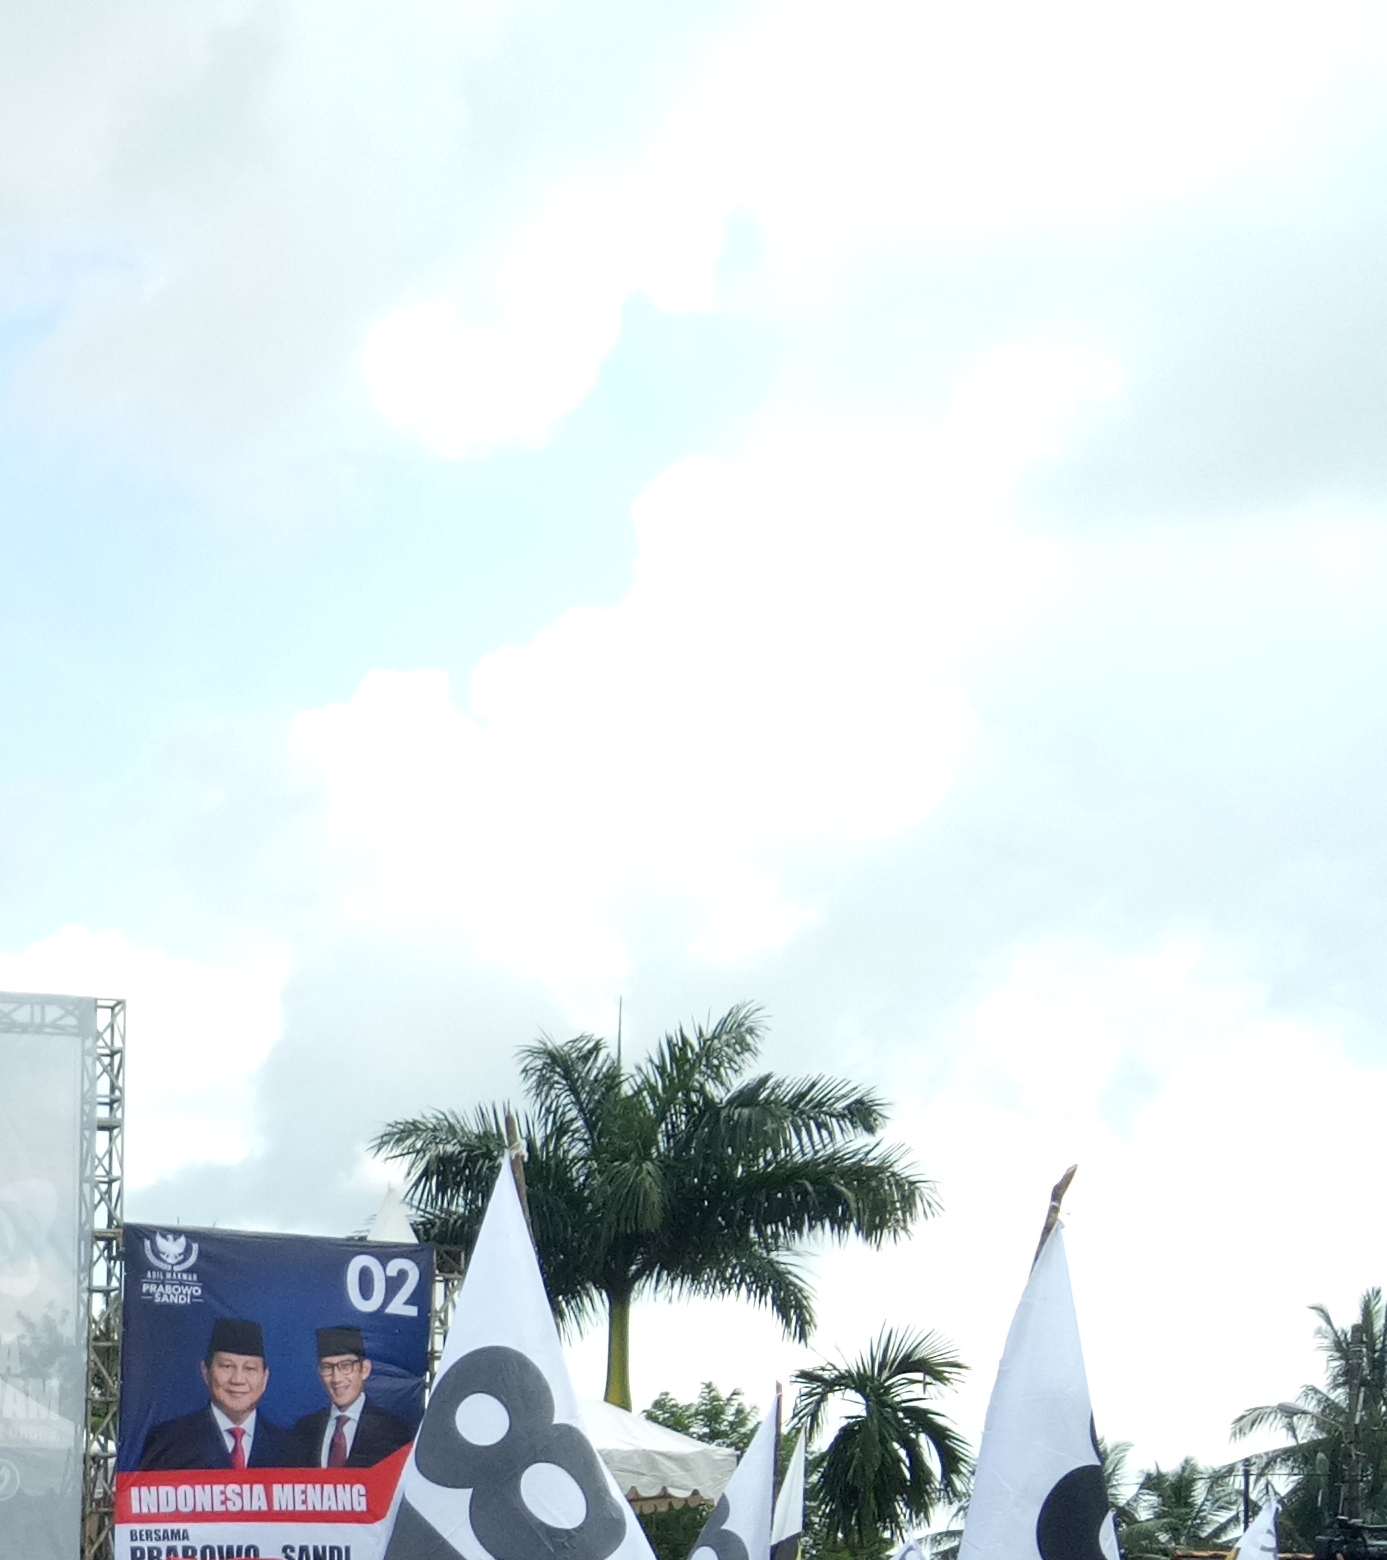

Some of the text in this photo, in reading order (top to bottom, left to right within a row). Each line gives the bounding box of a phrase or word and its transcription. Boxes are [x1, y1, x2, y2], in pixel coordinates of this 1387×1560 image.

[142, 1282, 202, 1296] PRABOWO
[346, 1254, 420, 1317] 02
[154, 1293, 191, 1304] SANDI
[130, 1484, 367, 1514] INDONESIA MENANG
[130, 1529, 190, 1541] BERSAMA
